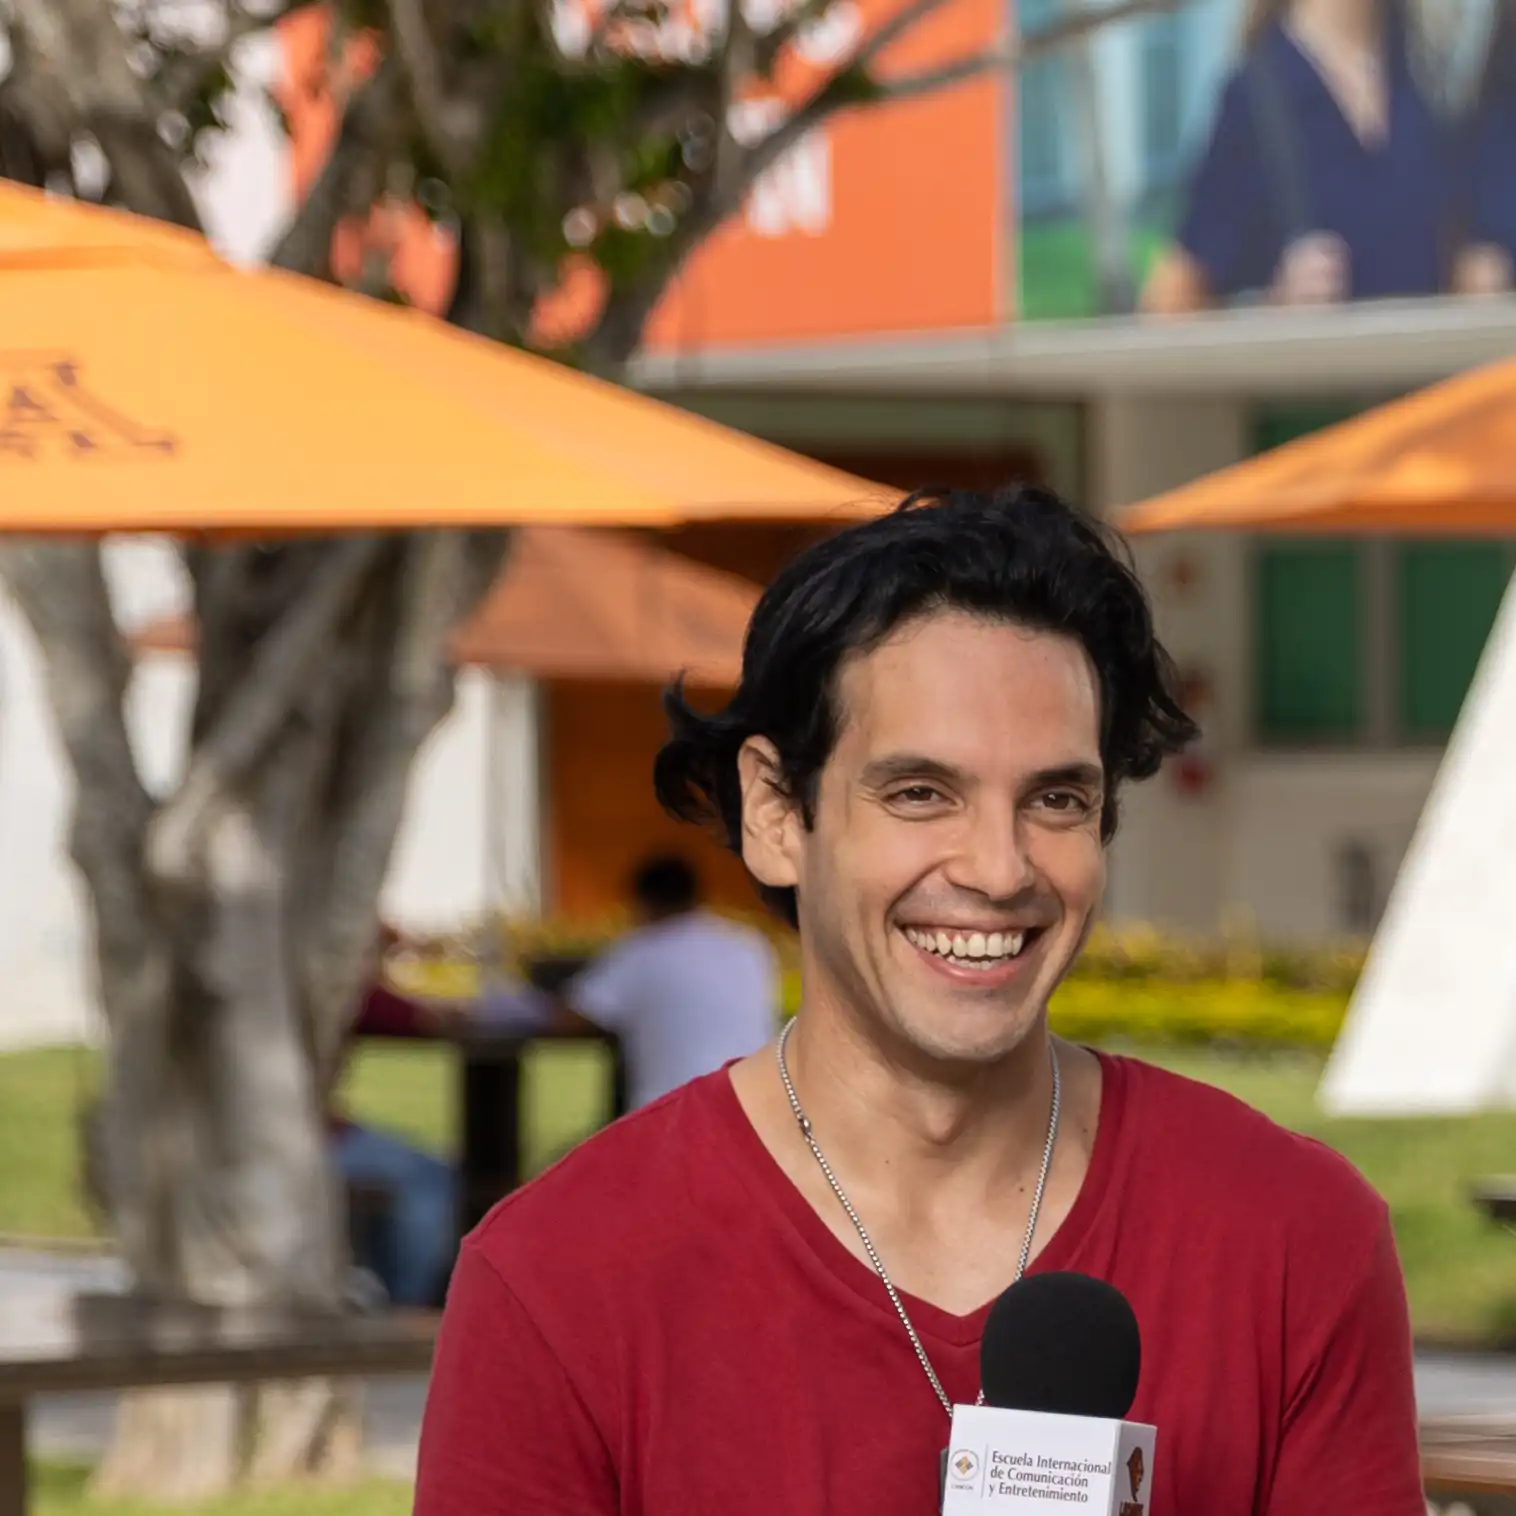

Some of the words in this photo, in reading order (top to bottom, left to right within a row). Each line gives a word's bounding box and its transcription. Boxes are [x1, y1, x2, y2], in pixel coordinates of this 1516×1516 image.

[992, 1451, 1033, 1467] Escuela
[1036, 1454, 1111, 1475] Internacional
[990, 1465, 1004, 1479] de
[1007, 1469, 1088, 1488] Comunicación
[988, 1484, 995, 1497] y
[999, 1483, 1088, 1503] Entretenimiento
